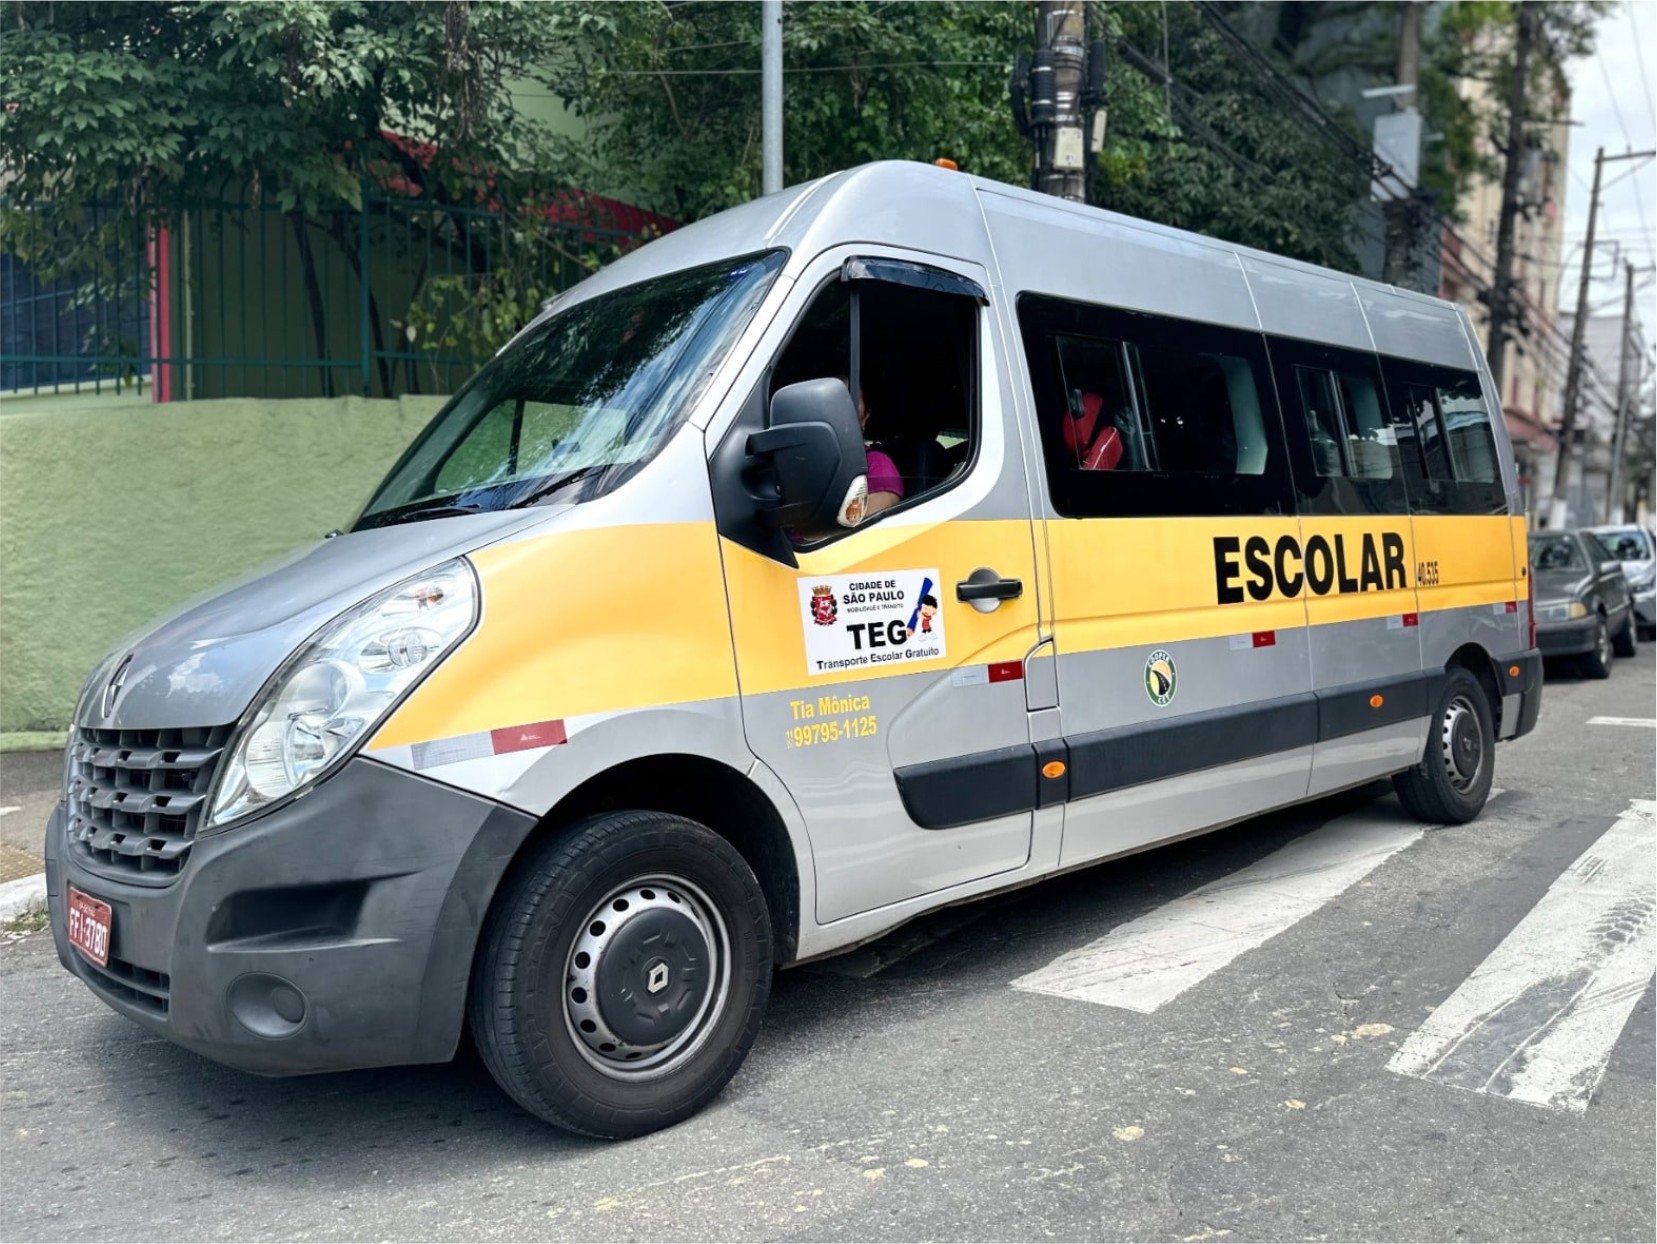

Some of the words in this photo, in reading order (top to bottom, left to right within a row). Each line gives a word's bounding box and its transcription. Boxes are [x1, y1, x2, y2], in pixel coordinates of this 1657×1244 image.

[1213, 532, 1407, 605] ESCOLAR
[843, 592, 866, 605] SÃO
[869, 590, 904, 602] PAULO
[849, 580, 882, 591] CIDADE
[884, 580, 896, 588] DE
[846, 619, 907, 650] TEG
[816, 656, 868, 671] Transporte
[870, 650, 903, 663] Escolar
[905, 647, 939, 659] Gratuito
[790, 700, 814, 720] Tia
[818, 694, 870, 716] Mônica
[793, 715, 877, 747] 99795-1125
